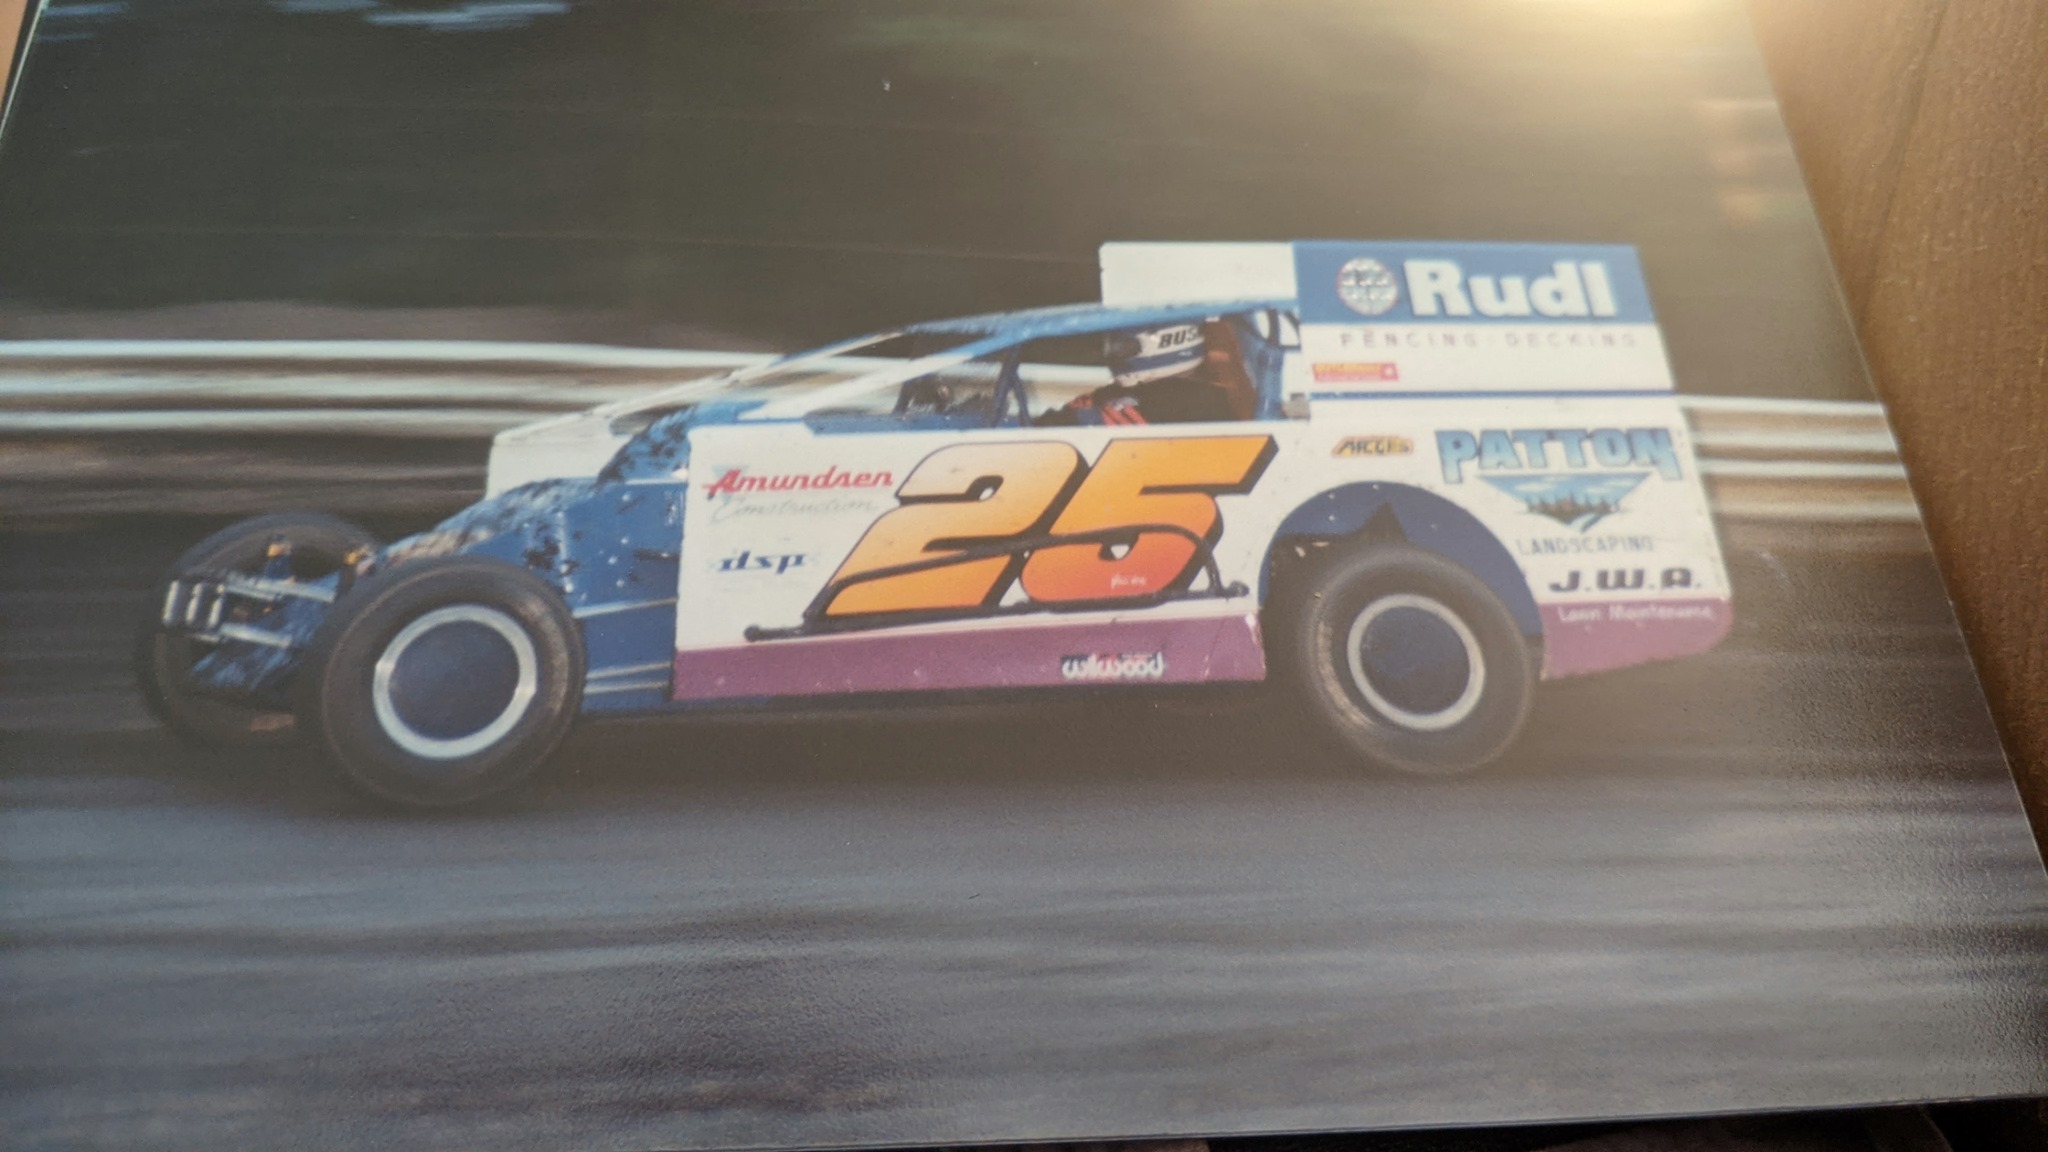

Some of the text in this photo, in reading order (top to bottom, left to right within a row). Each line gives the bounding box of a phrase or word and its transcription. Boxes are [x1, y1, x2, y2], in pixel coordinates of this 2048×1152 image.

[1403, 258, 1616, 317] Rudl
[1435, 428, 1683, 484] PATTON
[702, 465, 894, 499] Amundsen
[711, 499, 880, 523] Construction
[800, 434, 1280, 636] 25
[1516, 536, 1654, 555] LANDSCAPING
[1549, 568, 1702, 592] J.W.A.
